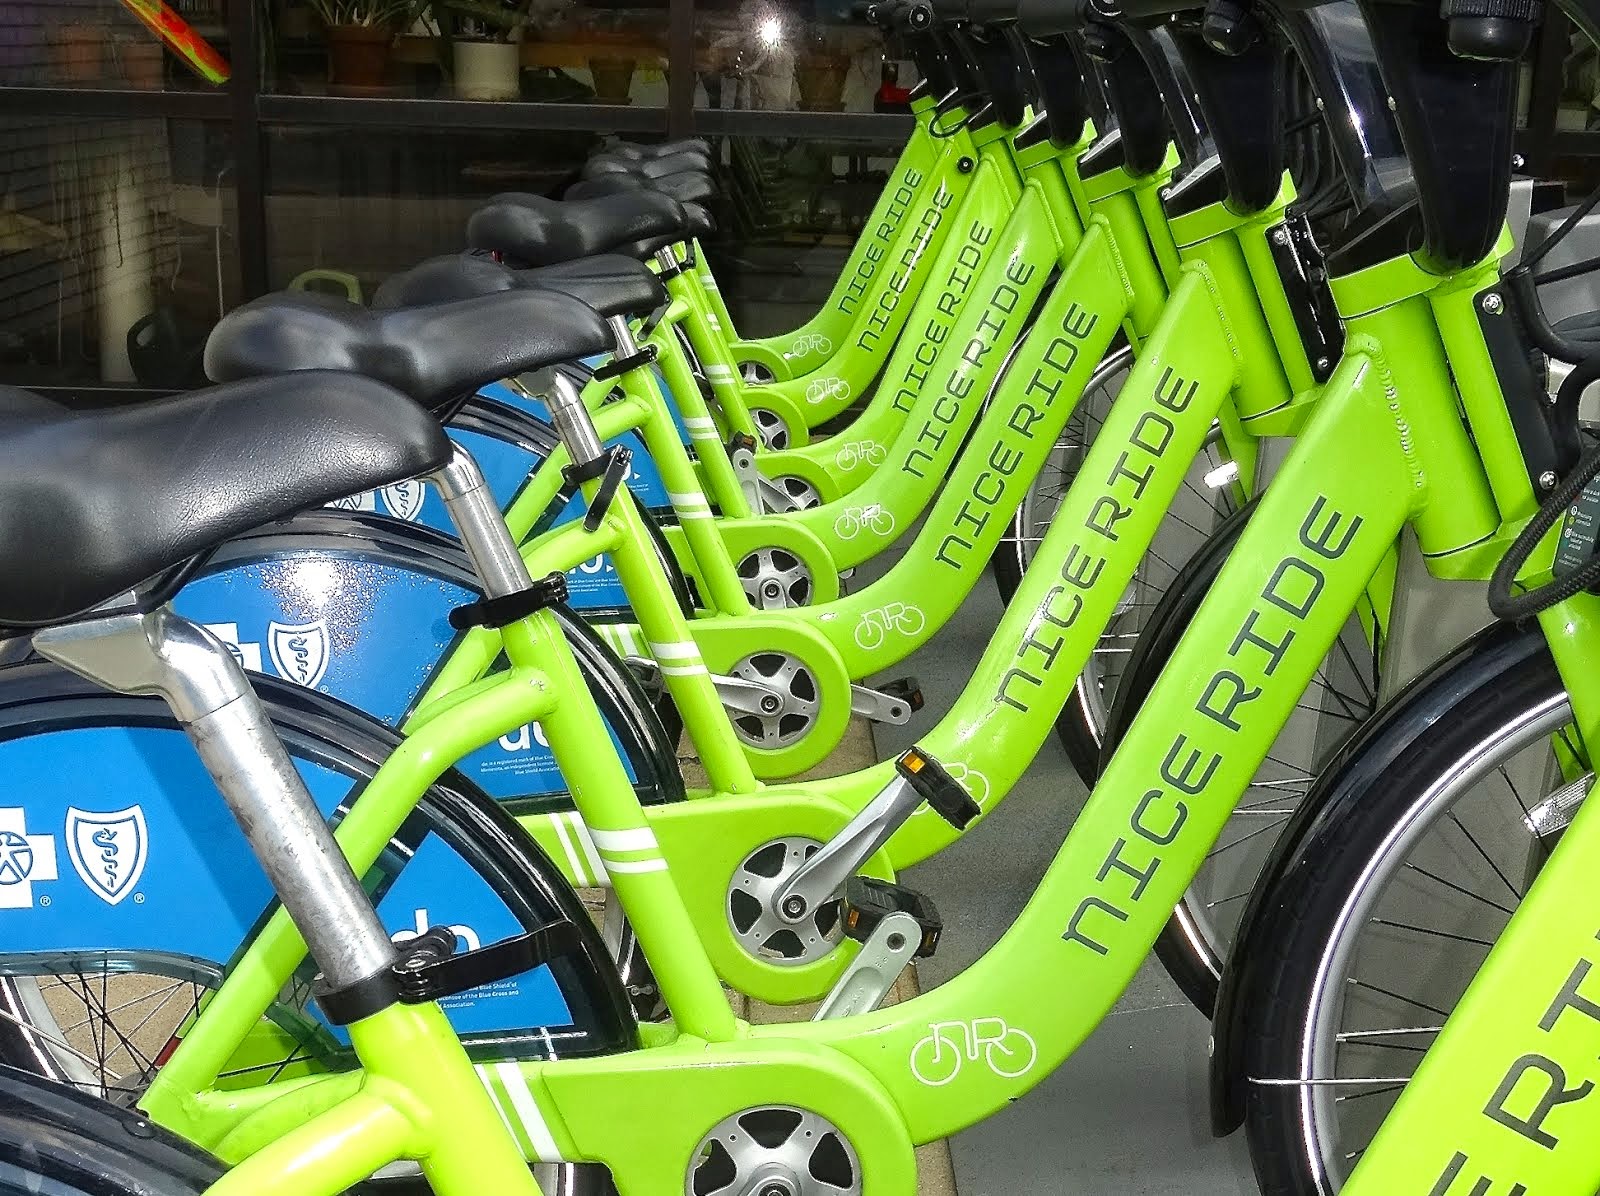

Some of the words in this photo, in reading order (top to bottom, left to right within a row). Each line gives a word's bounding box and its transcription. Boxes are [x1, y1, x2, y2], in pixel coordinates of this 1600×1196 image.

[839, 243, 884, 315] NICE
[876, 169, 922, 242] RIDE
[892, 319, 948, 413] NICE
[938, 221, 992, 317] RIDE
[900, 182, 954, 270] RIDE
[902, 370, 974, 478] NICE
[962, 263, 1035, 368] RIDE
[935, 440, 1023, 569] NICE
[1008, 303, 1098, 439] RIDE
[994, 544, 1106, 713] NICE
[1085, 366, 1199, 541] RIDE
[1062, 734, 1222, 955] NICE
[1195, 496, 1363, 732] RIDE
